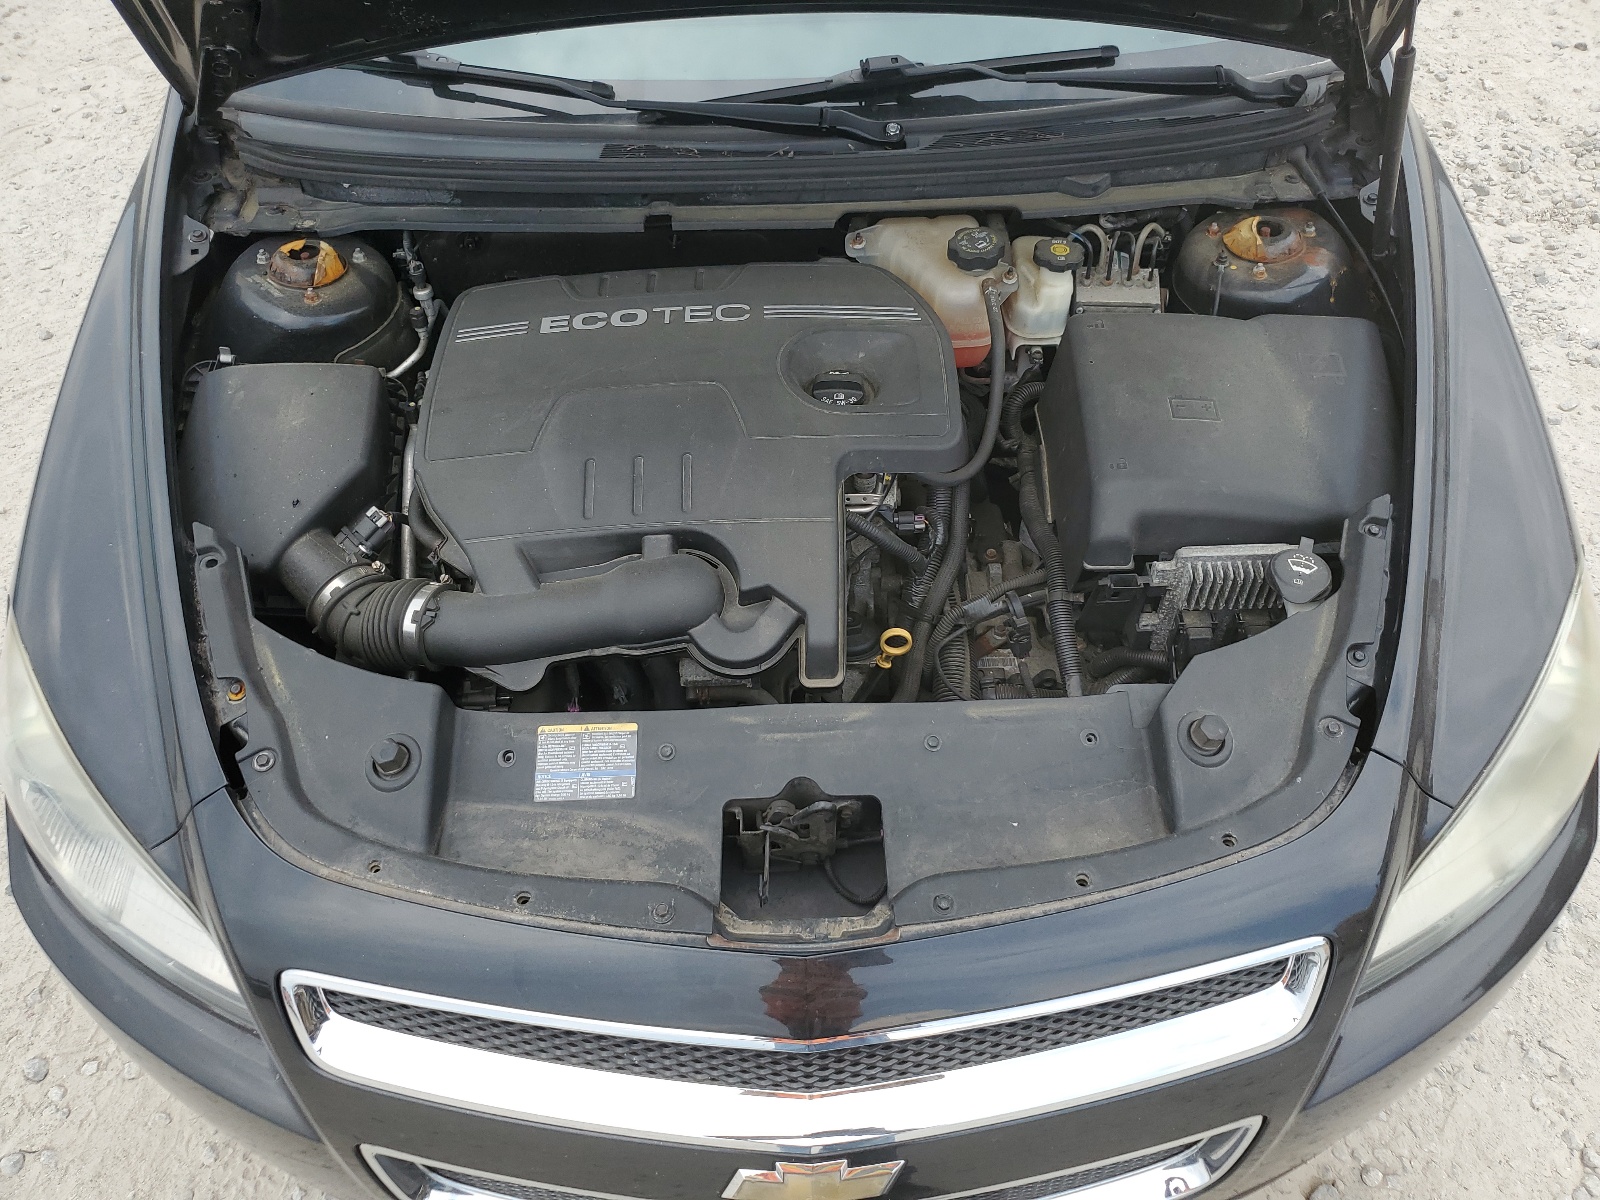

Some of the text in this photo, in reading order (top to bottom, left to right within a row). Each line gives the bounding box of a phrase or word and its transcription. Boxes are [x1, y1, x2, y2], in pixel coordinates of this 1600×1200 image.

[539, 303, 751, 334] ECOTEC
[820, 396, 858, 406] SAE 5W-30
